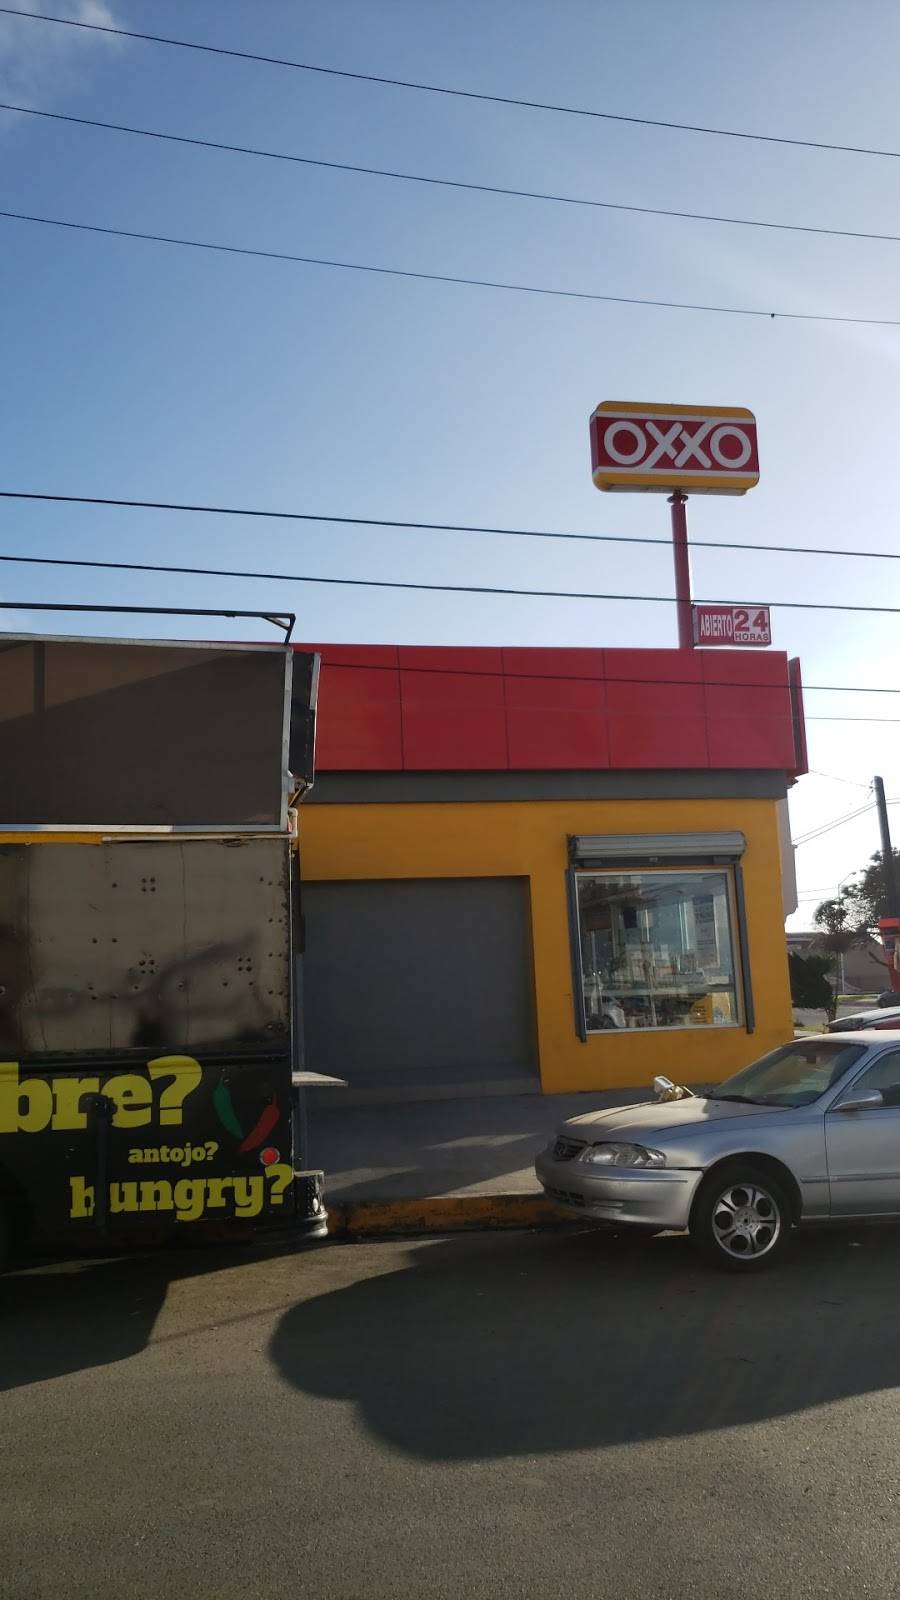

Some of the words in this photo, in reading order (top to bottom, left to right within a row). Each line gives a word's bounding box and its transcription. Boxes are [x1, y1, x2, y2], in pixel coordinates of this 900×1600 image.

[604, 421, 752, 469] OXXO
[701, 614, 734, 637] ABIERTO
[734, 610, 769, 632] 24
[735, 632, 769, 642] HORAS
[128, 1141, 219, 1166] antojo?
